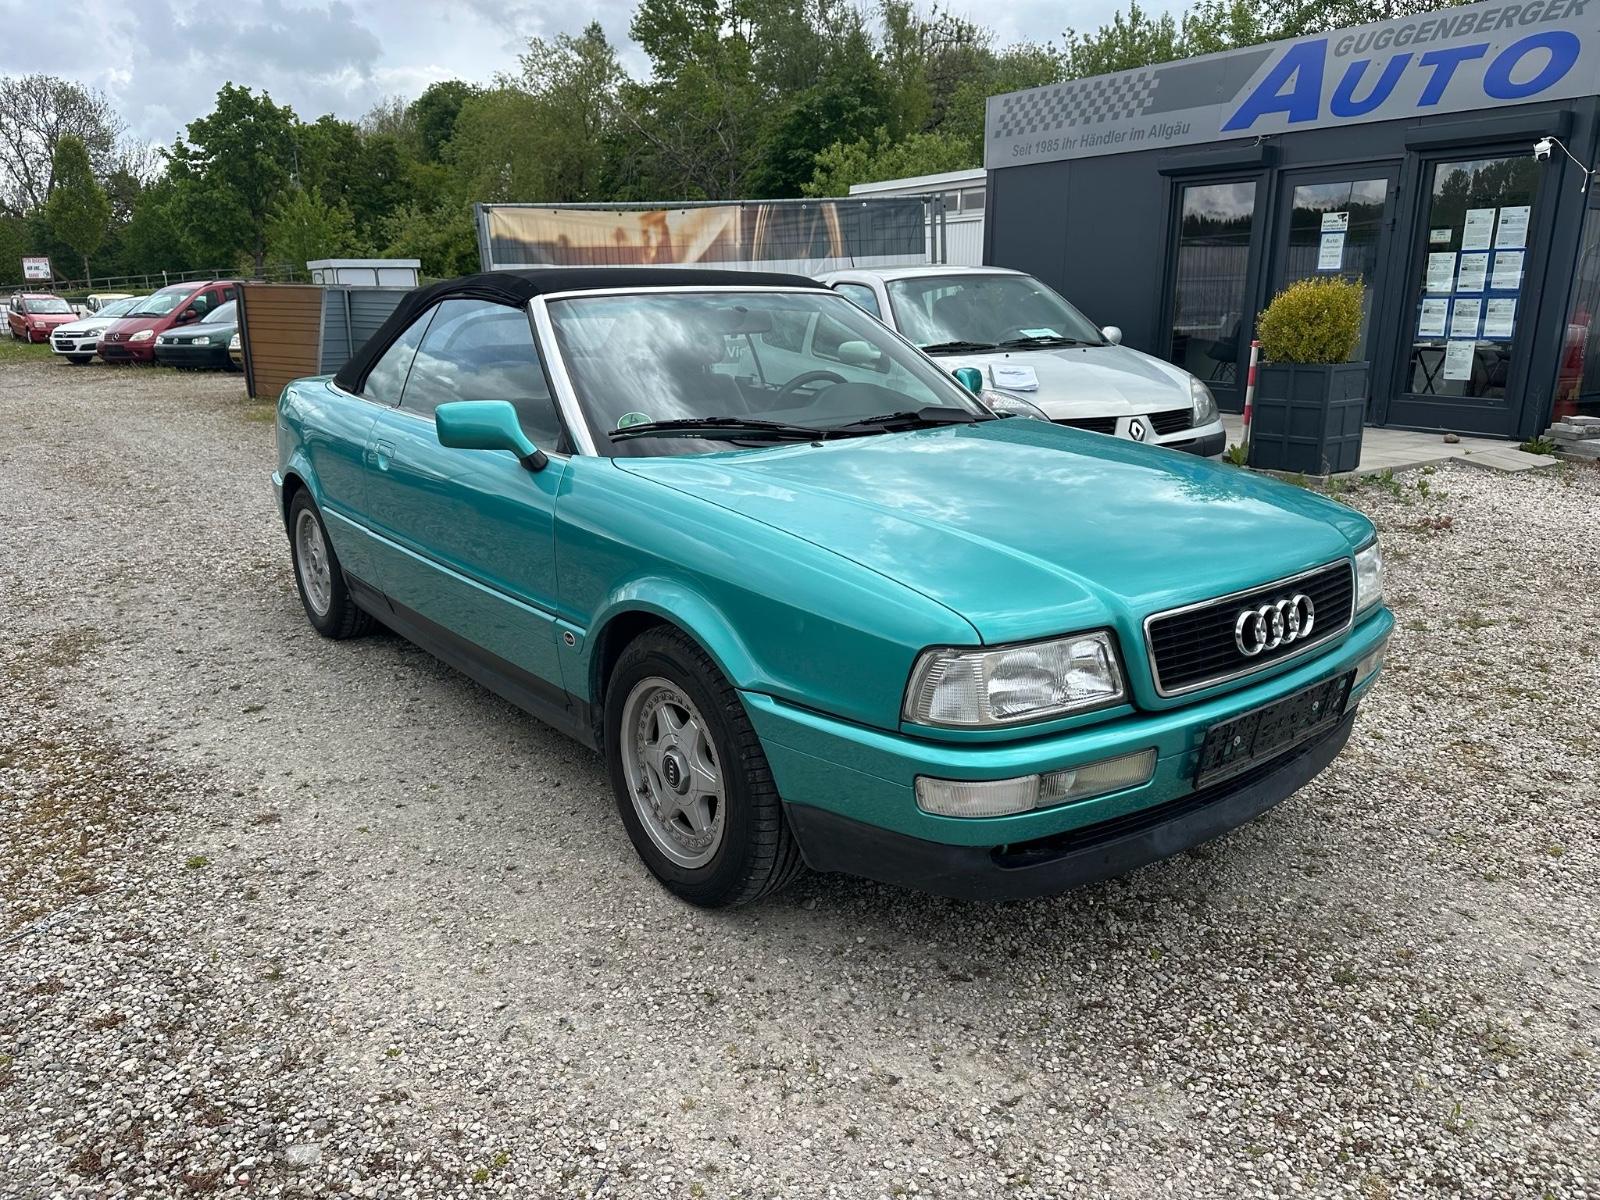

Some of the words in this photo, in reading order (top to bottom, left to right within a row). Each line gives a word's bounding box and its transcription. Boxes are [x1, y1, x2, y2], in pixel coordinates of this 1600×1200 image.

[1334, 0, 1588, 57] GUGGENBERGER
[1220, 30, 1581, 132] AUTO
[1012, 143, 1032, 157] Seit
[1035, 138, 1060, 154] 1985
[1062, 137, 1078, 150] ihr
[1080, 131, 1126, 149] Händler
[1129, 127, 1145, 141] im
[1148, 121, 1191, 140] Allgäu
